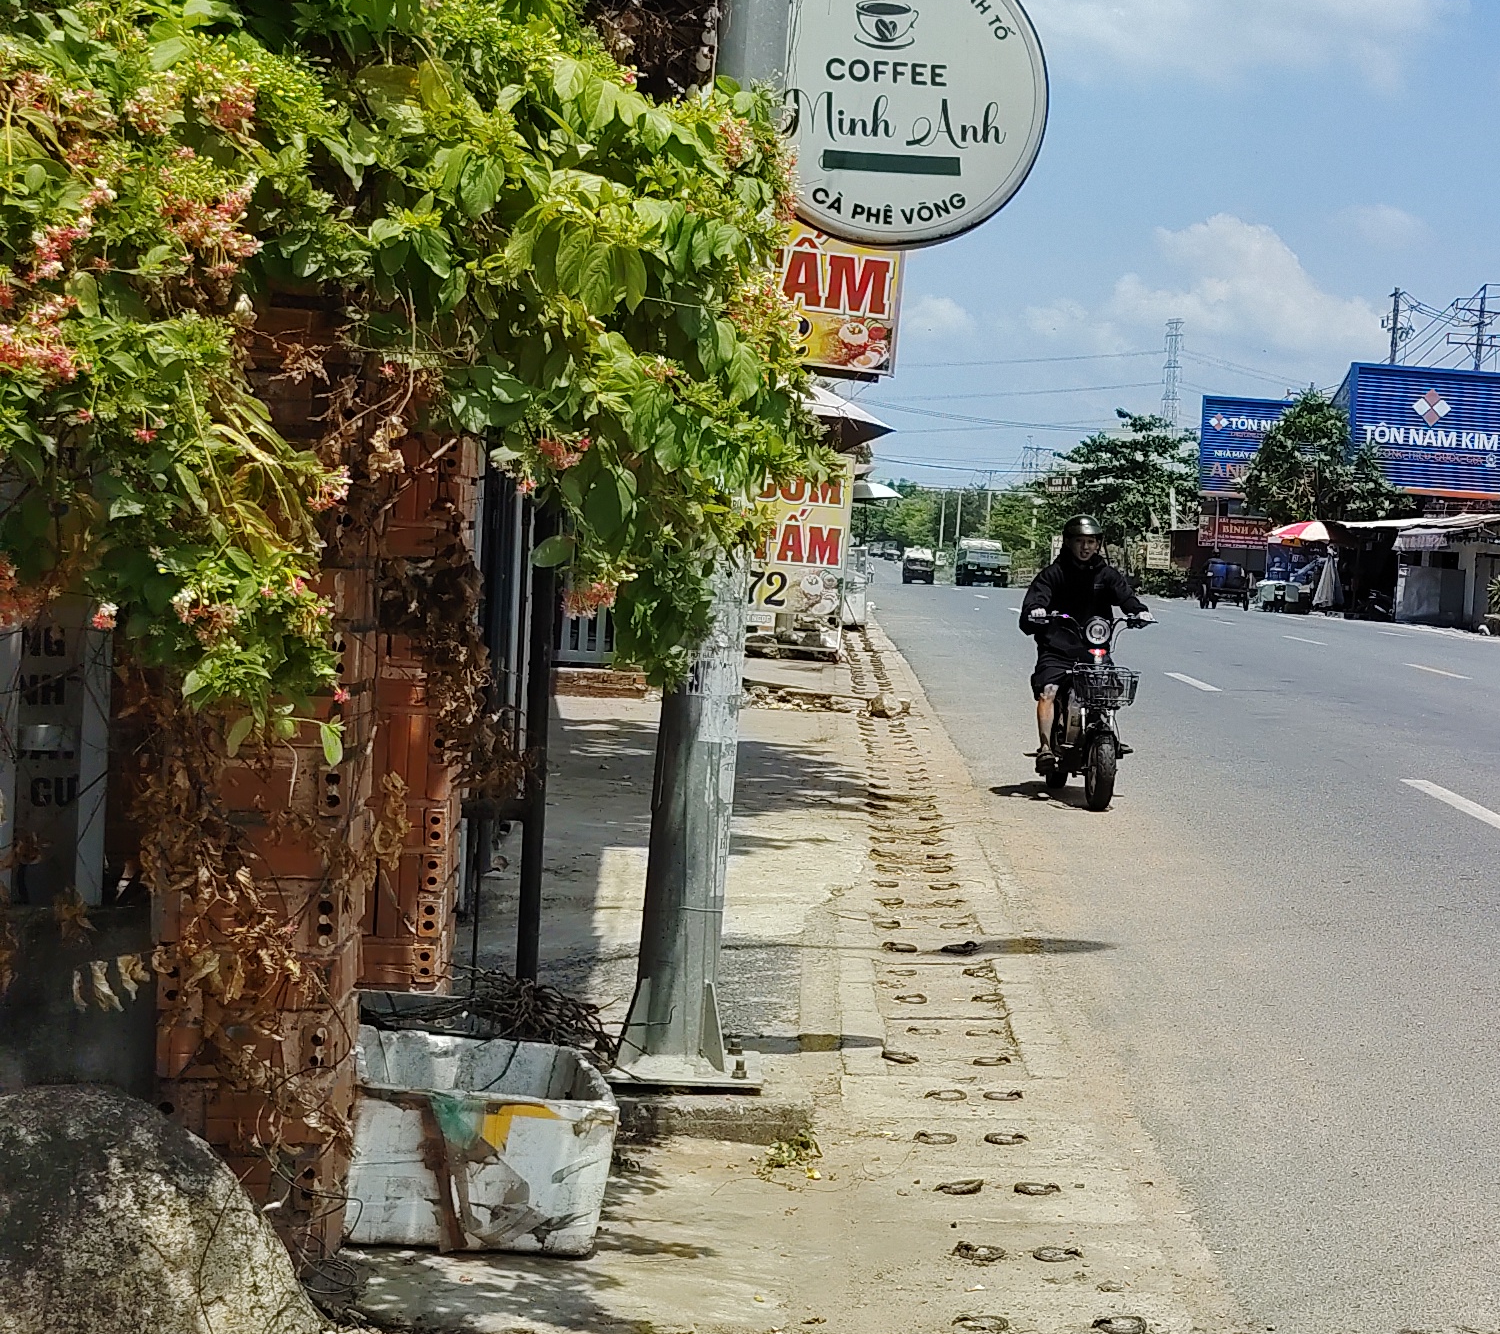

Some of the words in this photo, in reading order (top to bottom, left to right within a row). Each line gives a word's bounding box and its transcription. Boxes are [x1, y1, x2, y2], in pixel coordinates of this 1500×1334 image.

[988, 15, 1016, 41] TỐ
[826, 58, 947, 87] COFFEE
[782, 88, 897, 143] Minh
[906, 98, 1007, 149] Anh
[812, 187, 843, 214] CÀ
[851, 205, 893, 225] PHÊ
[900, 193, 966, 224] VÕNG
[776, 231, 893, 317] ẤM
[1229, 416, 1258, 431] TÔN
[1363, 422, 1405, 445] TÔN
[1409, 428, 1457, 447] NAM
[1461, 432, 1499, 451] KIM
[1222, 523, 1249, 535] BÌNH
[748, 570, 788, 607] 72
